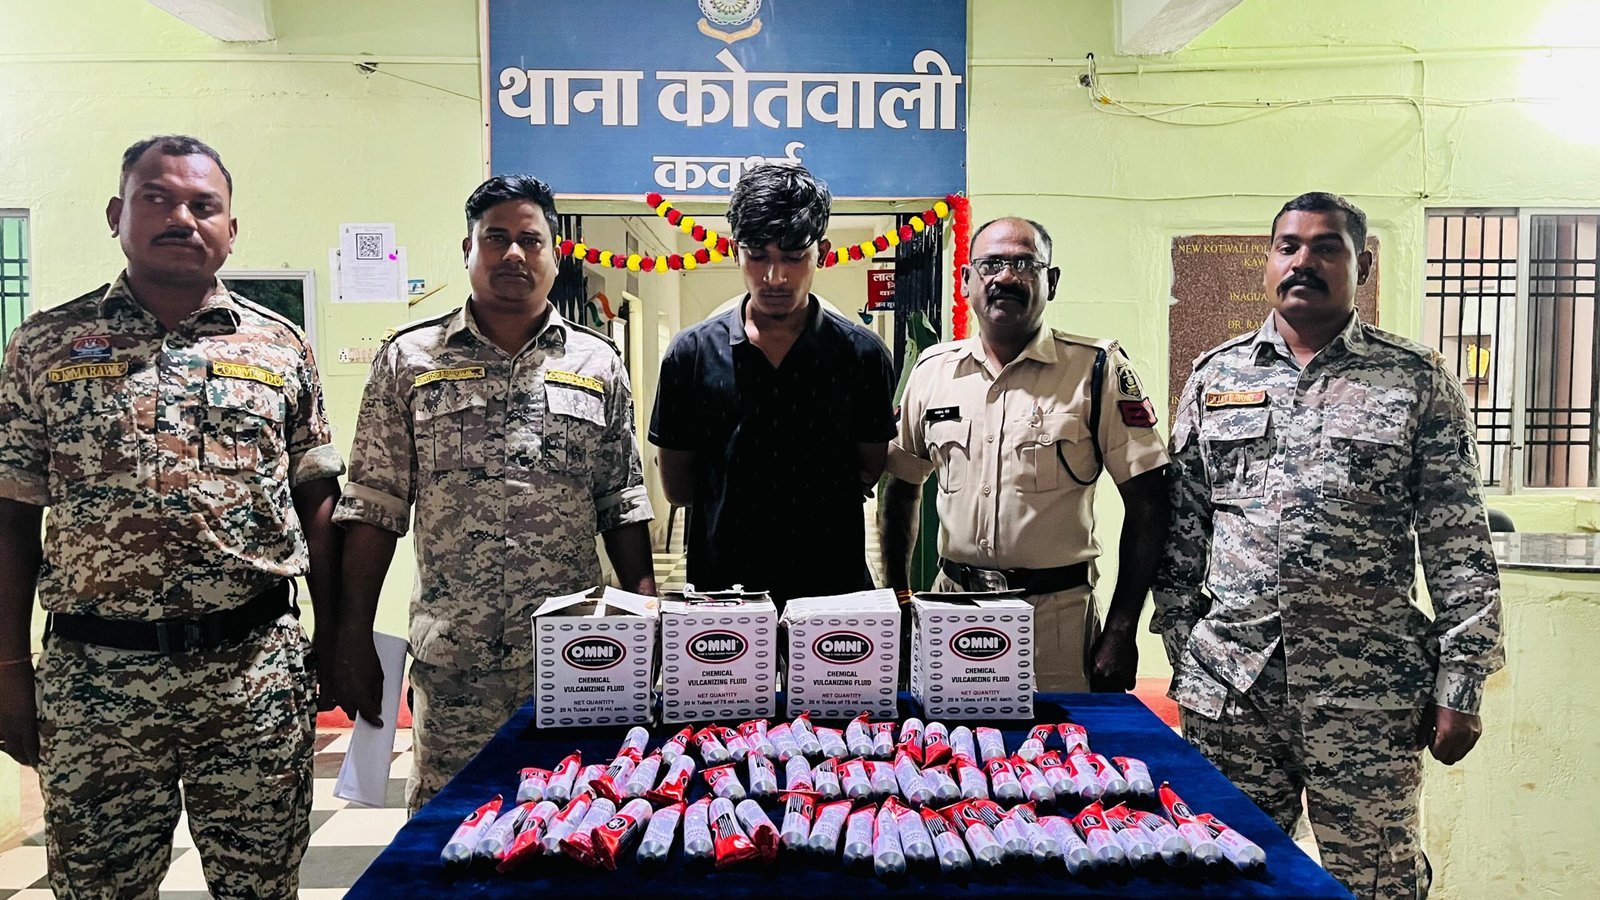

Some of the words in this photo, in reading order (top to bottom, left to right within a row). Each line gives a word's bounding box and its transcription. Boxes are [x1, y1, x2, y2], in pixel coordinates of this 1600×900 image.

[498, 66, 643, 126] थाना
[656, 48, 963, 130] कोतवाली
[653, 141, 805, 191] कवर्
[1179, 244, 1201, 253] NEW
[1203, 244, 1249, 253] KOTWALI
[695, 639, 736, 652] OMNI
[821, 640, 862, 652] OMNI
[958, 637, 999, 649] OMNI
[571, 646, 614, 658] OMNI
